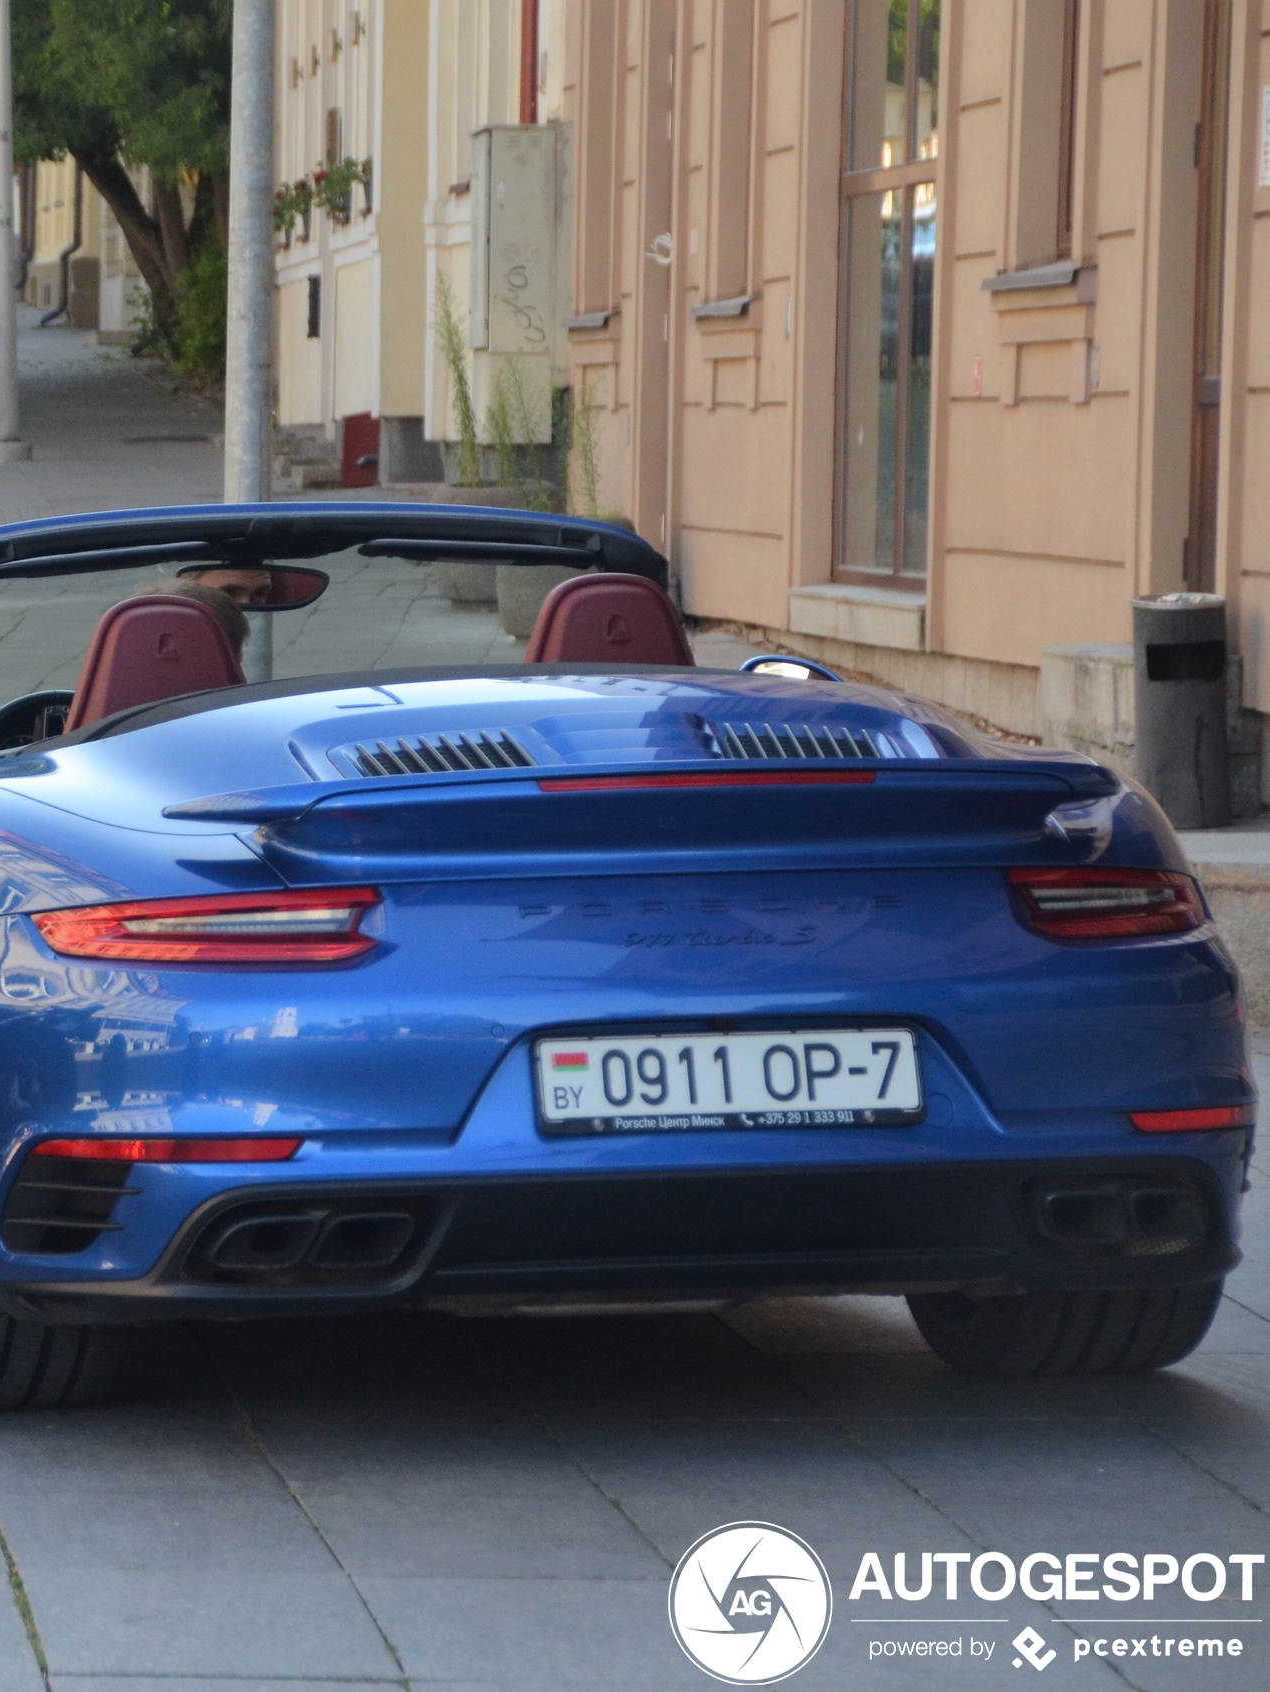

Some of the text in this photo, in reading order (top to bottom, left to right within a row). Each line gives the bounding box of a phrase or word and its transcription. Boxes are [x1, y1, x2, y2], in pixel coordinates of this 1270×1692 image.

[519, 895, 903, 919] PORSCHE
[624, 932, 678, 948] 911
[779, 925, 818, 946] S
[601, 1041, 901, 1107] 0911 OP-7
[553, 1085, 584, 1110] BY
[616, 1117, 657, 1129] Porsche
[659, 1116, 690, 1129] Центр
[758, 1113, 785, 1125] +375
[787, 1112, 801, 1124] 29
[814, 1111, 835, 1123] 333
[838, 1110, 855, 1122] 911
